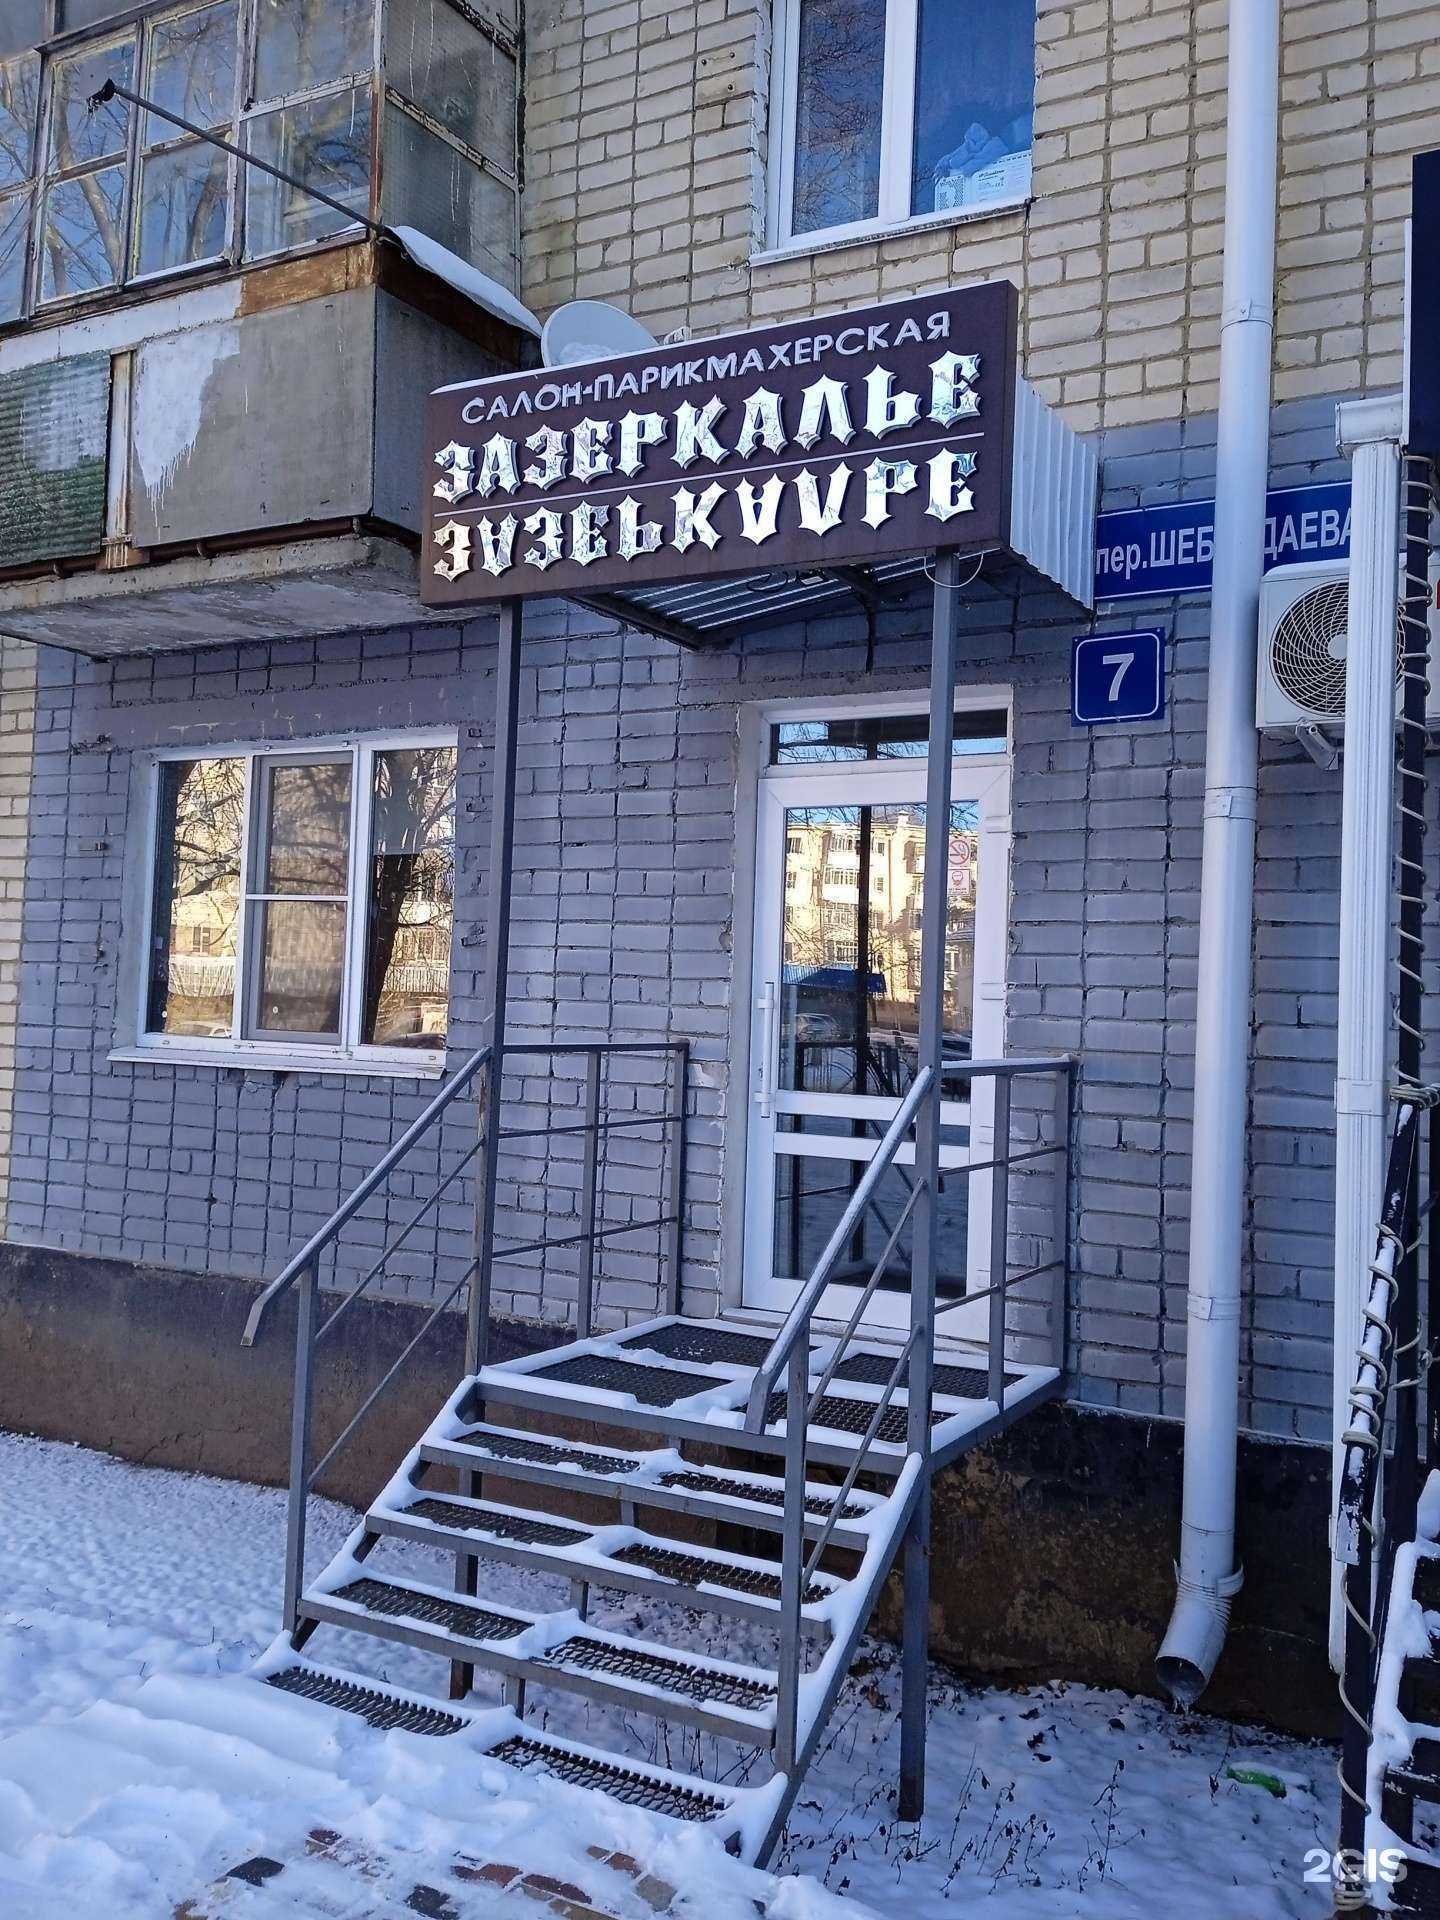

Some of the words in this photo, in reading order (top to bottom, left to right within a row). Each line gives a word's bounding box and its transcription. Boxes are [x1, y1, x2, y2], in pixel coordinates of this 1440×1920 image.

[461, 310, 951, 425] САЛОН-ПАРИКМАХЕРСКАЯ
[432, 350, 982, 504] ЗАЗЕРКАЛЬЕ
[1102, 652, 1135, 702] 7
